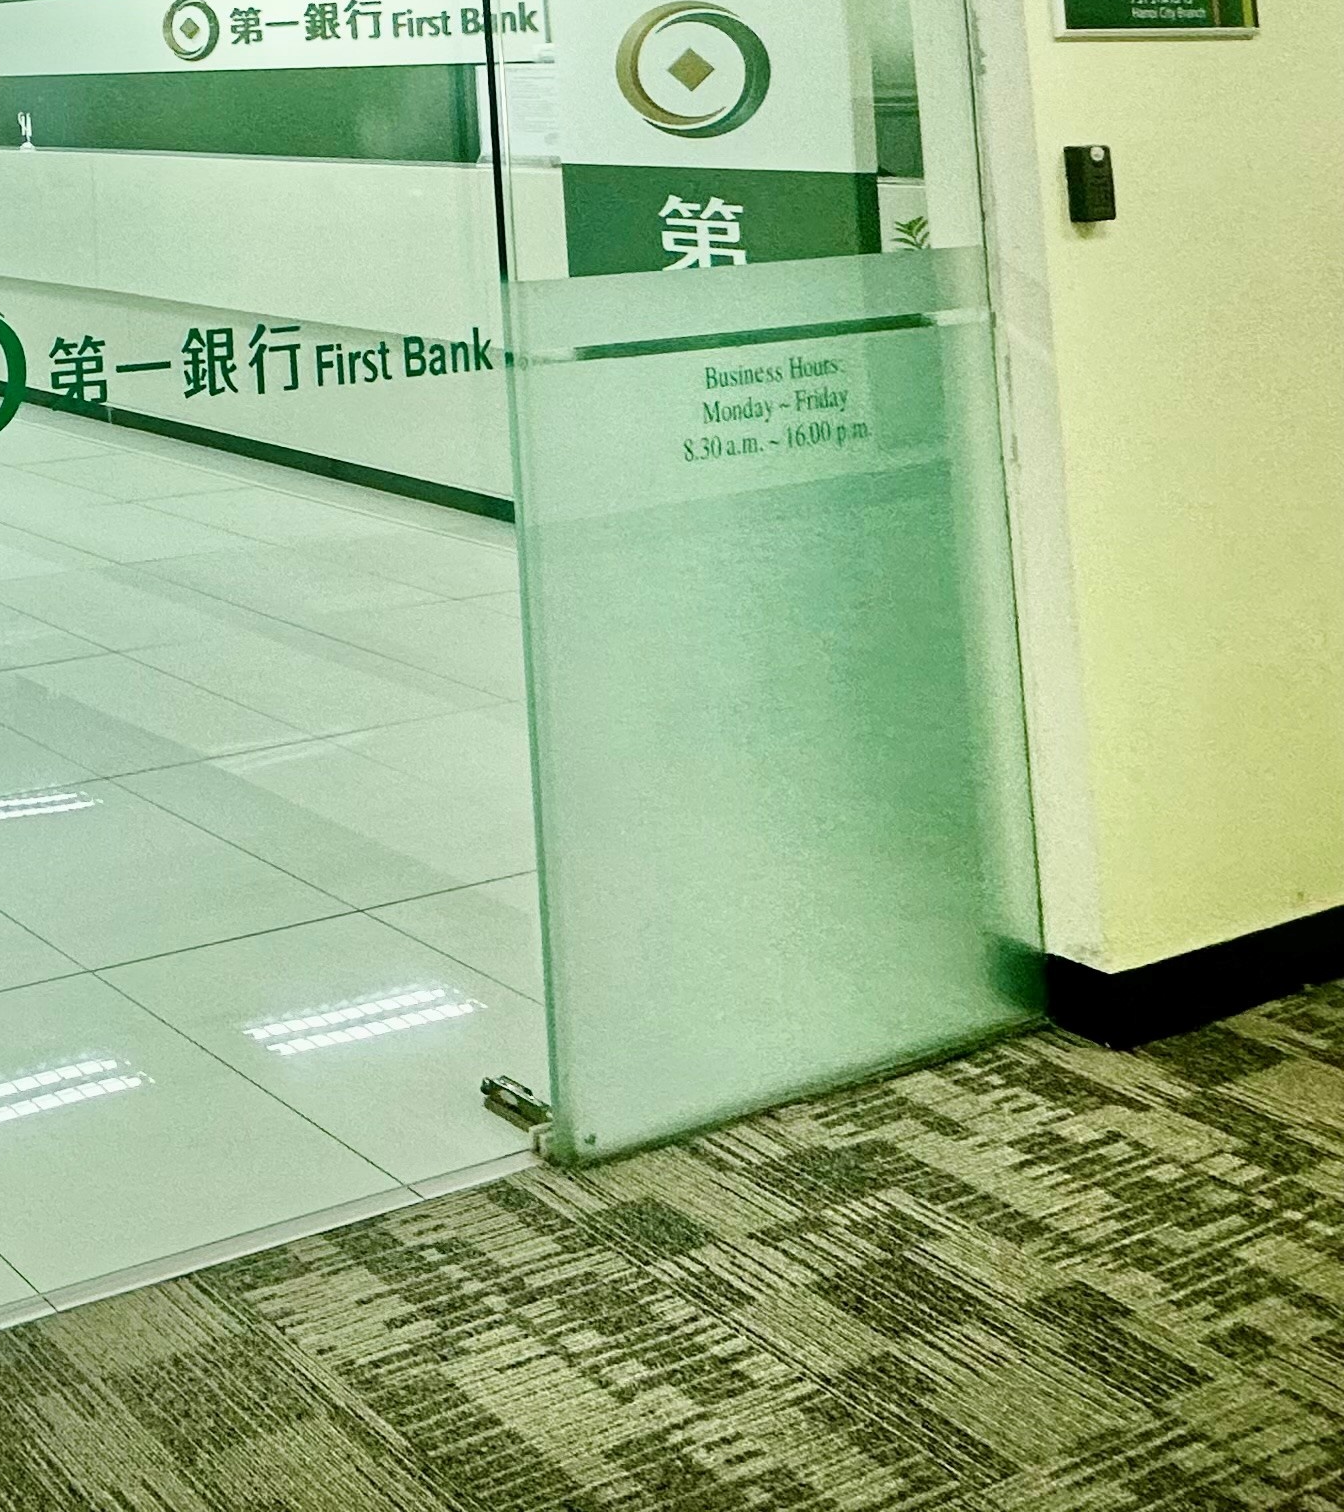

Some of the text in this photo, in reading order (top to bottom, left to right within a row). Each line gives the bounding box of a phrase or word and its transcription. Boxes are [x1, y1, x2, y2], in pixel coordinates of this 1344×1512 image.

[229, 0, 382, 45] 第一銀行
[392, 8, 452, 38] First
[658, 194, 748, 272] 第
[48, 324, 495, 412] 第一銀行 First Bank
[705, 364, 783, 390] Business
[703, 397, 772, 425] Monday
[795, 386, 849, 413] Friday
[726, 437, 764, 456] a.m.
